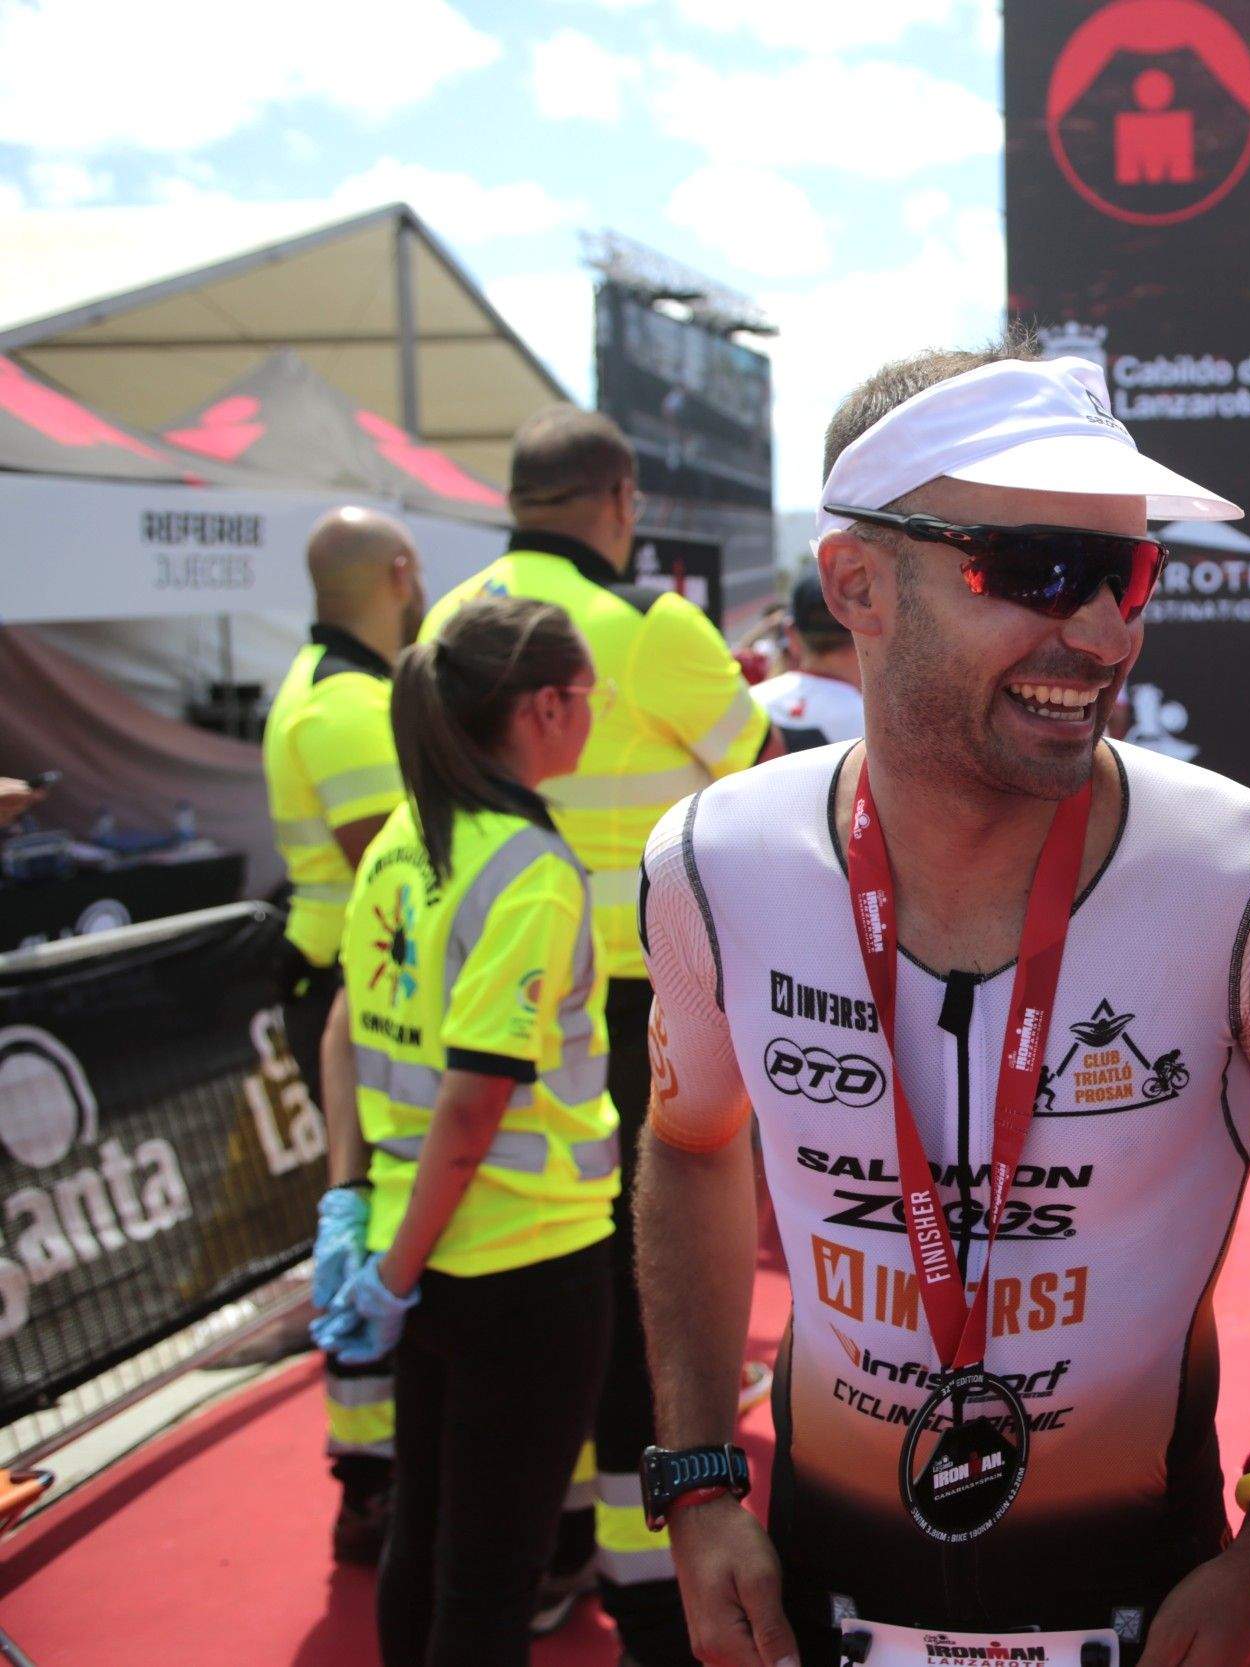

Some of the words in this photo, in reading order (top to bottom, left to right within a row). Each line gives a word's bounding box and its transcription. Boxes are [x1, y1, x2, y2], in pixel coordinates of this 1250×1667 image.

[1113, 353, 1234, 388] Cabildo
[140, 510, 266, 546] REFEREE
[1015, 1007, 1035, 1071] IRONMAN
[770, 1049, 878, 1095] PTO
[1083, 1049, 1120, 1069] CLUB
[1074, 1082, 1133, 1104] PROSAN
[910, 1189, 952, 1285] FINISHER
[955, 1374, 984, 1388] EDITION
[911, 1506, 928, 1530] SWIM
[951, 1532, 967, 1543] BIKE
[995, 1500, 1011, 1519] RUN
[926, 1642, 1045, 1661] IRONMAN
